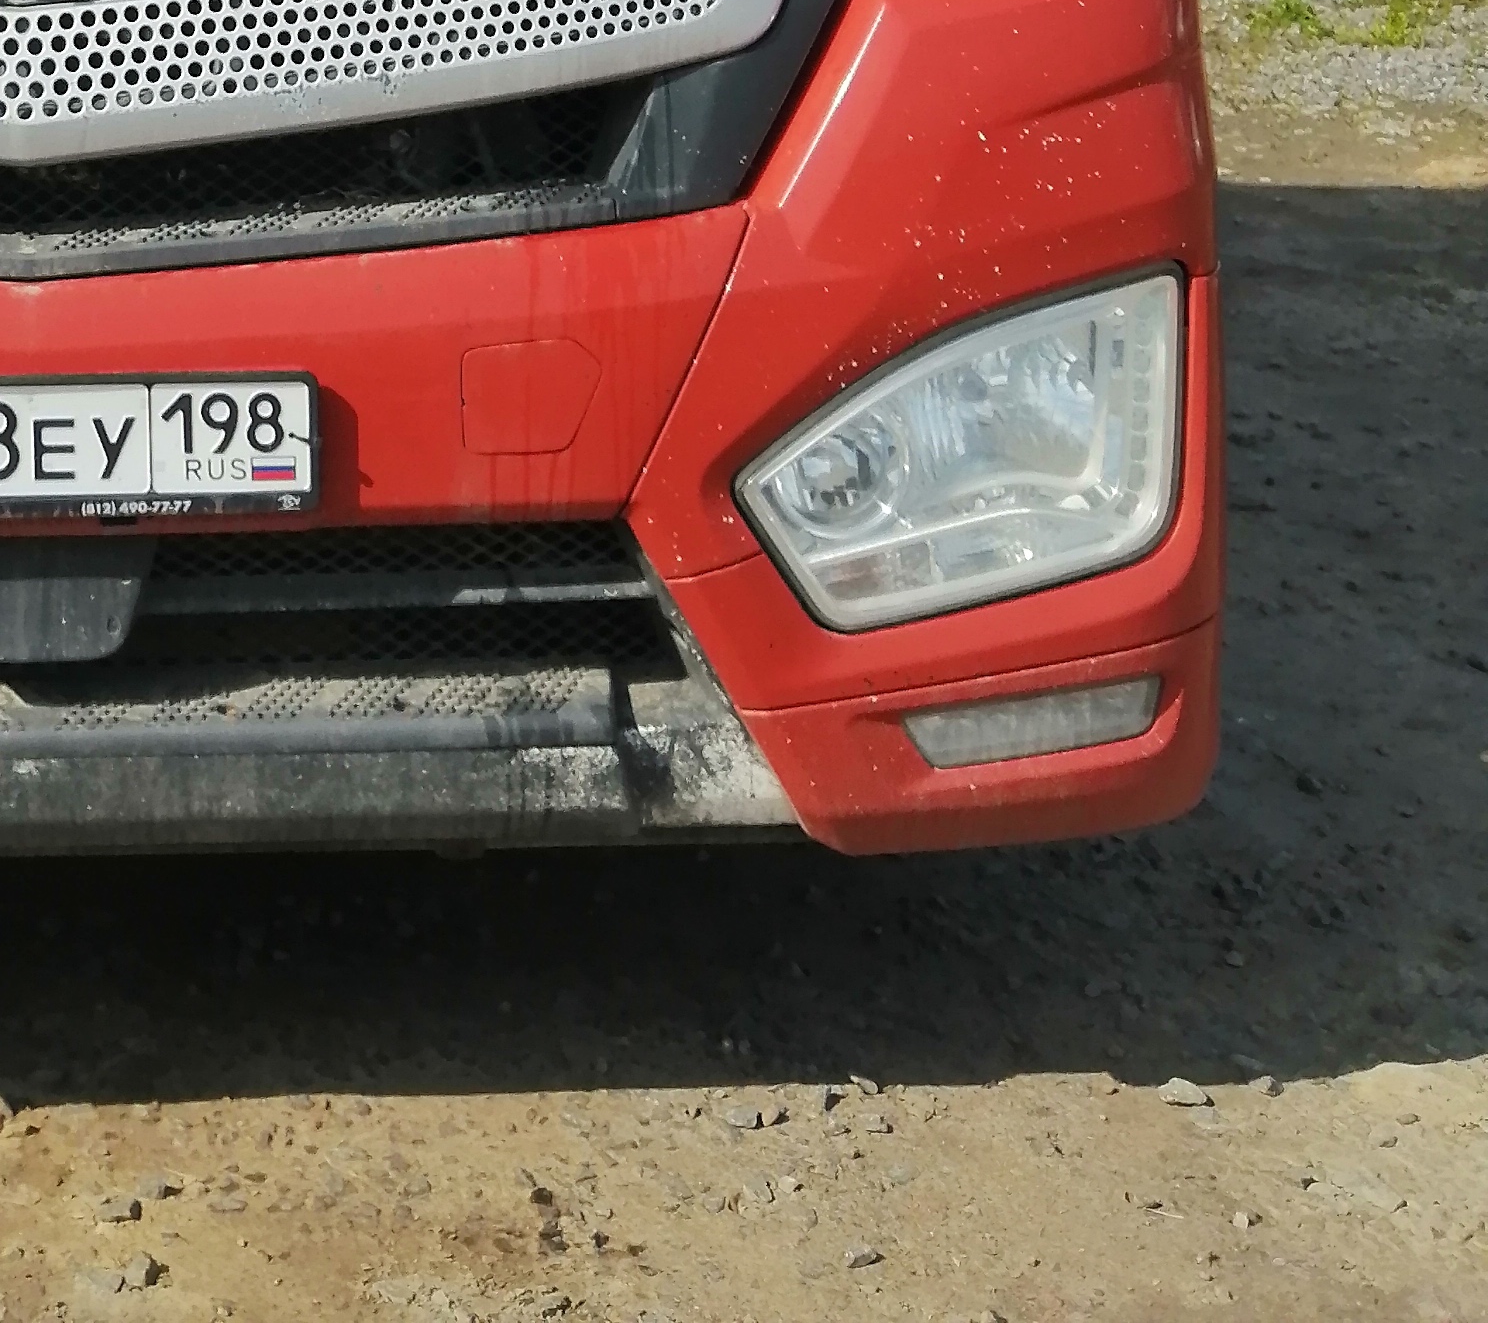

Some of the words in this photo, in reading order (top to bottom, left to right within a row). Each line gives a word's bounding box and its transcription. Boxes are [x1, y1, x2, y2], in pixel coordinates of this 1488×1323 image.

[161, 391, 284, 454] 198
[184, 456, 247, 481] RUS
[80, 500, 117, 518] (812)
[119, 499, 192, 515] 490-77-77
